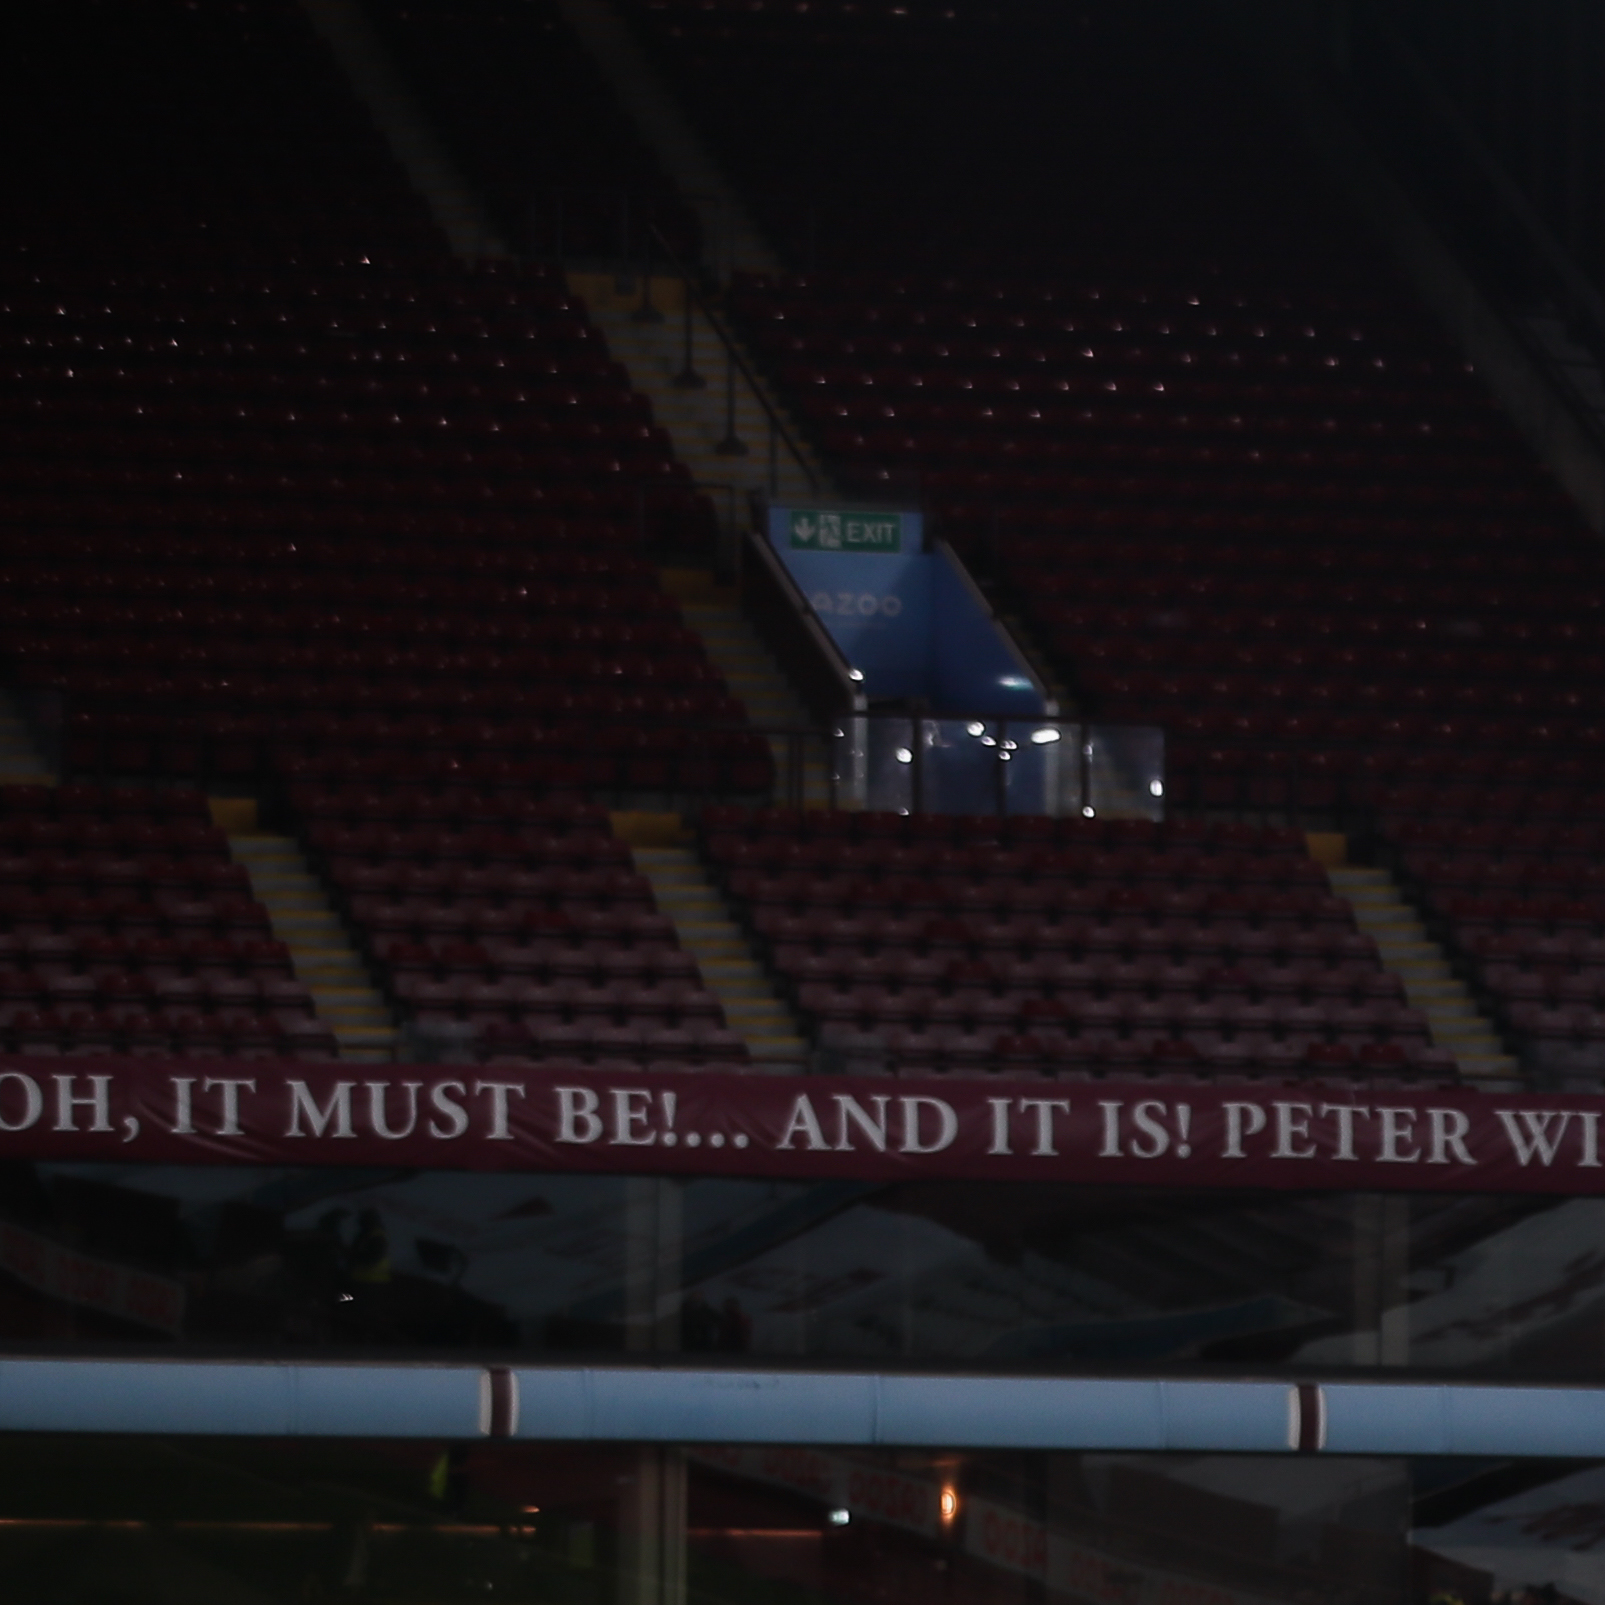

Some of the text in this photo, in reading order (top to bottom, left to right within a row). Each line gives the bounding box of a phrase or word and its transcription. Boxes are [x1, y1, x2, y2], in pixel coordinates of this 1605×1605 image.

[846, 522, 896, 544] EXIT
[171, 1077, 258, 1135] IT
[285, 1080, 526, 1140] MUST
[776, 1092, 958, 1155] AND
[986, 1097, 1070, 1157] IT
[1097, 1101, 1193, 1159] IS!
[1220, 1102, 1479, 1167] PETER
